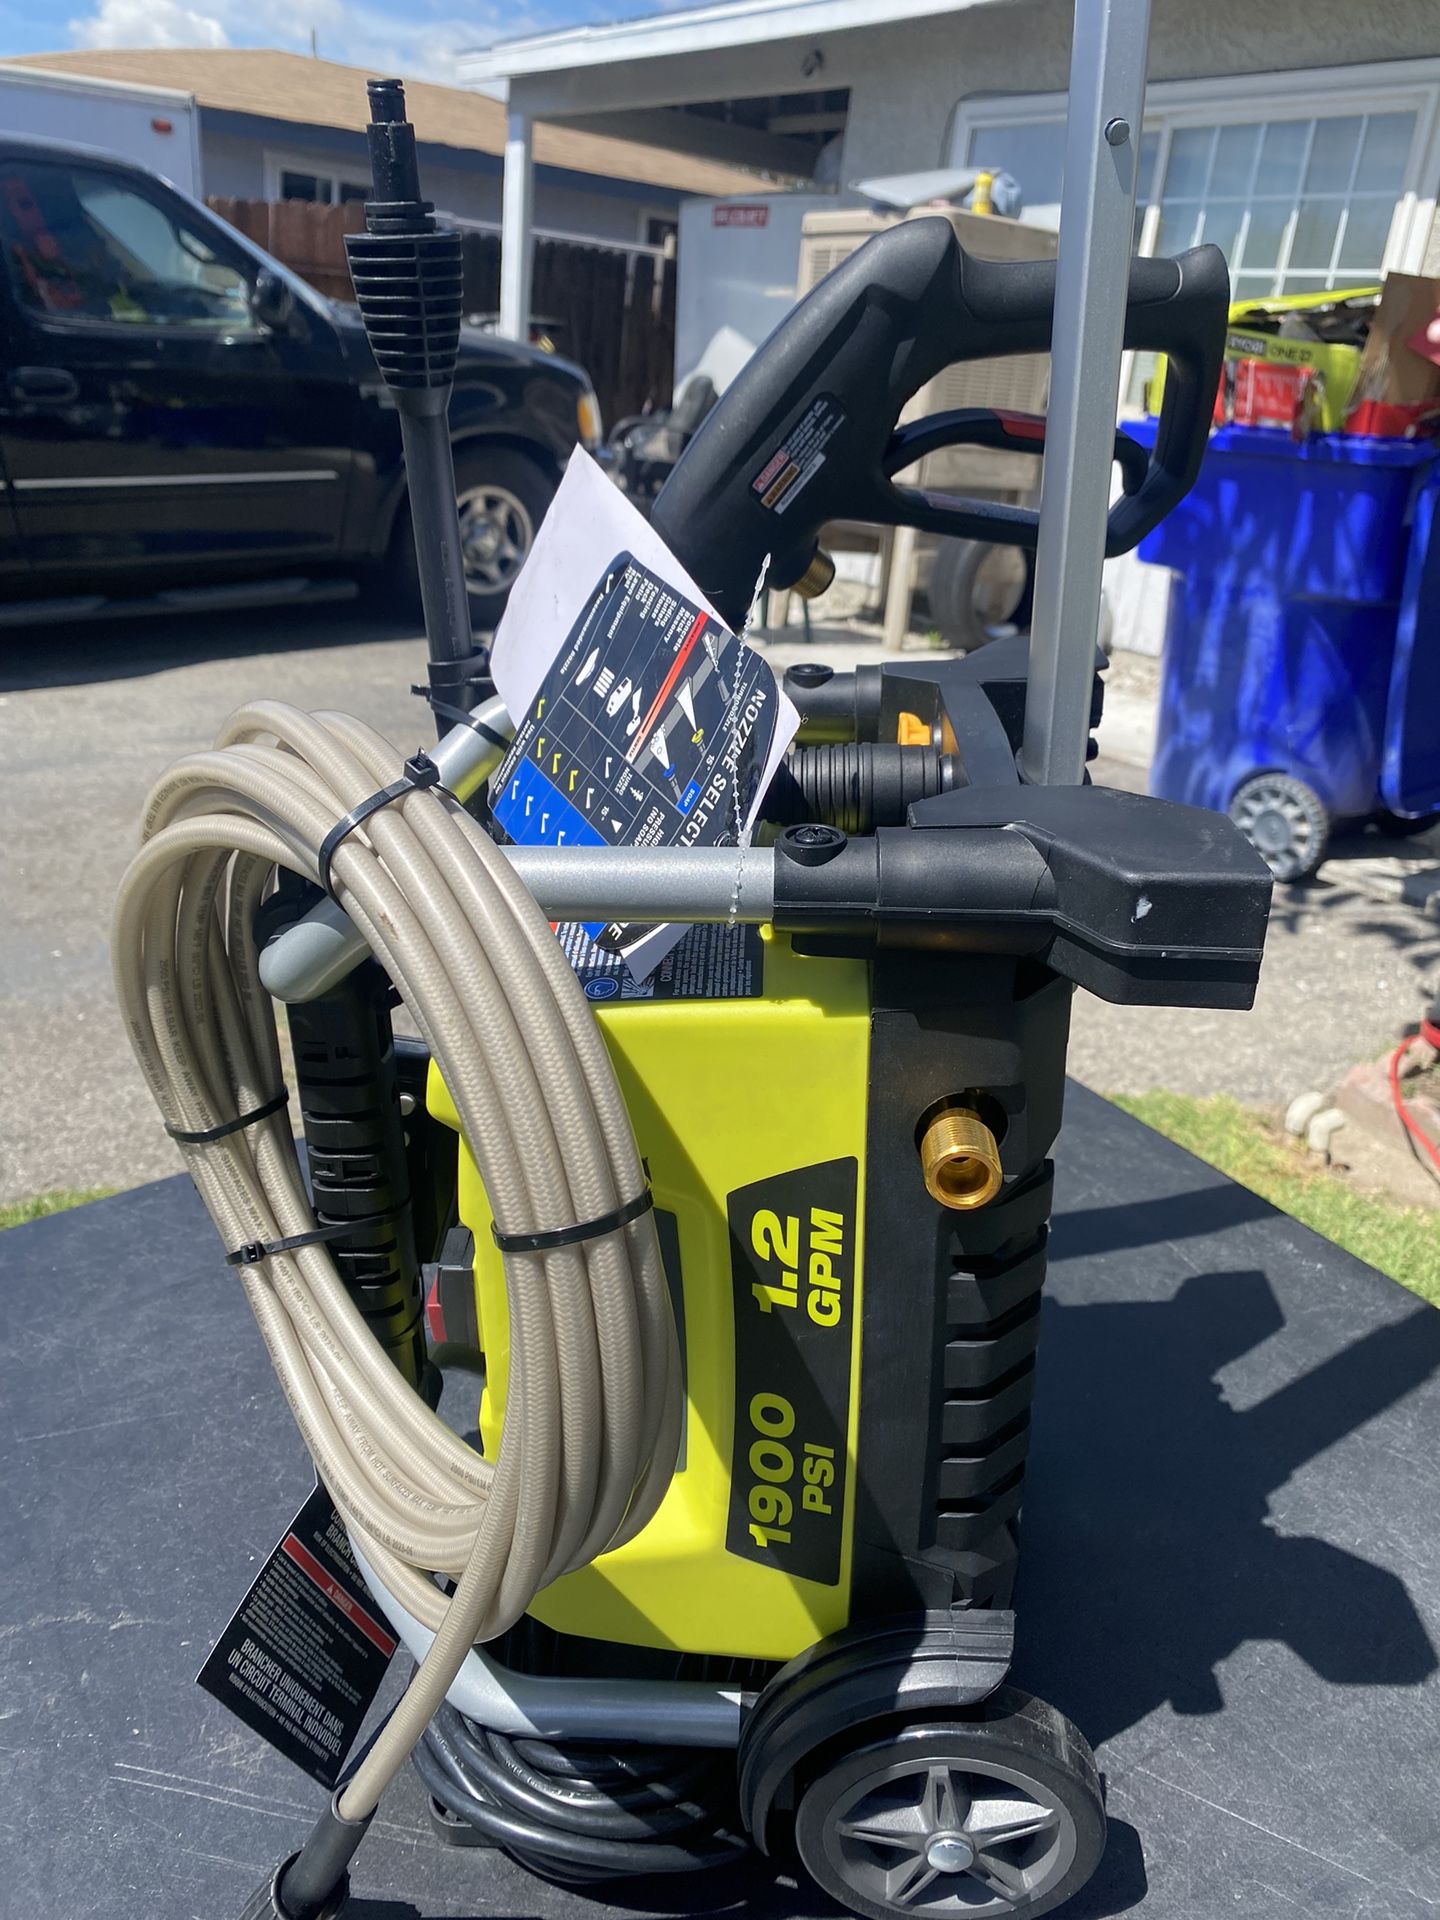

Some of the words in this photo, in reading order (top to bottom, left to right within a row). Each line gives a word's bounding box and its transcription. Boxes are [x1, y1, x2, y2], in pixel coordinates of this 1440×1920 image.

[627, 572, 642, 595] Lawn
[635, 578, 649, 601] Patio
[640, 581, 655, 604] Deck
[639, 585, 660, 620] Fencing
[651, 592, 668, 619] House
[654, 596, 672, 627] Gutters
[660, 599, 678, 628] Siding
[573, 592, 605, 652] Recommended
[606, 595, 631, 639] Equipment
[663, 606, 686, 644] Masonry
[676, 610, 691, 634] Brick
[672, 614, 696, 652] Concrete
[560, 650, 576, 675] nozzle
[524, 724, 535, 739] Use
[721, 688, 767, 774] NOZZLE
[515, 739, 526, 756] with
[629, 735, 642, 758] GENTLE
[493, 745, 517, 790] applications
[501, 755, 517, 783] caution
[613, 766, 631, 794] NOZZLE
[618, 773, 633, 797] TURBO
[683, 787, 696, 808] SOAP
[646, 806, 660, 825] (NO
[675, 773, 728, 847] SELECT
[640, 811, 666, 847] PRESSU
[650, 828, 665, 847] HIG
[166, 1017, 178, 1039] BAR
[171, 1040, 187, 1067] KEEP
[182, 1070, 200, 1098] AWAY
[195, 1101, 215, 1129] FROM
[220, 1153, 252, 1205] SURFACES
[247, 1205, 263, 1228] MAX
[750, 1208, 800, 1314] 1.2
[806, 1206, 844, 1328] GPM
[343, 1412, 361, 1435] AWAY
[359, 1435, 376, 1457] FROM
[370, 1456, 386, 1472] HOT
[748, 1392, 796, 1549] 1900
[802, 1441, 836, 1515] PSI
[240, 1637, 283, 1684] BRANCHER
[279, 1671, 327, 1721] UNIQUEMENT
[322, 1710, 345, 1738] DANS
[227, 1648, 243, 1669] UN
[239, 1659, 273, 1695] CIRCUIT
[268, 1683, 303, 1725] TERMINAL
[302, 1714, 343, 1758] INDIVIDUEL
